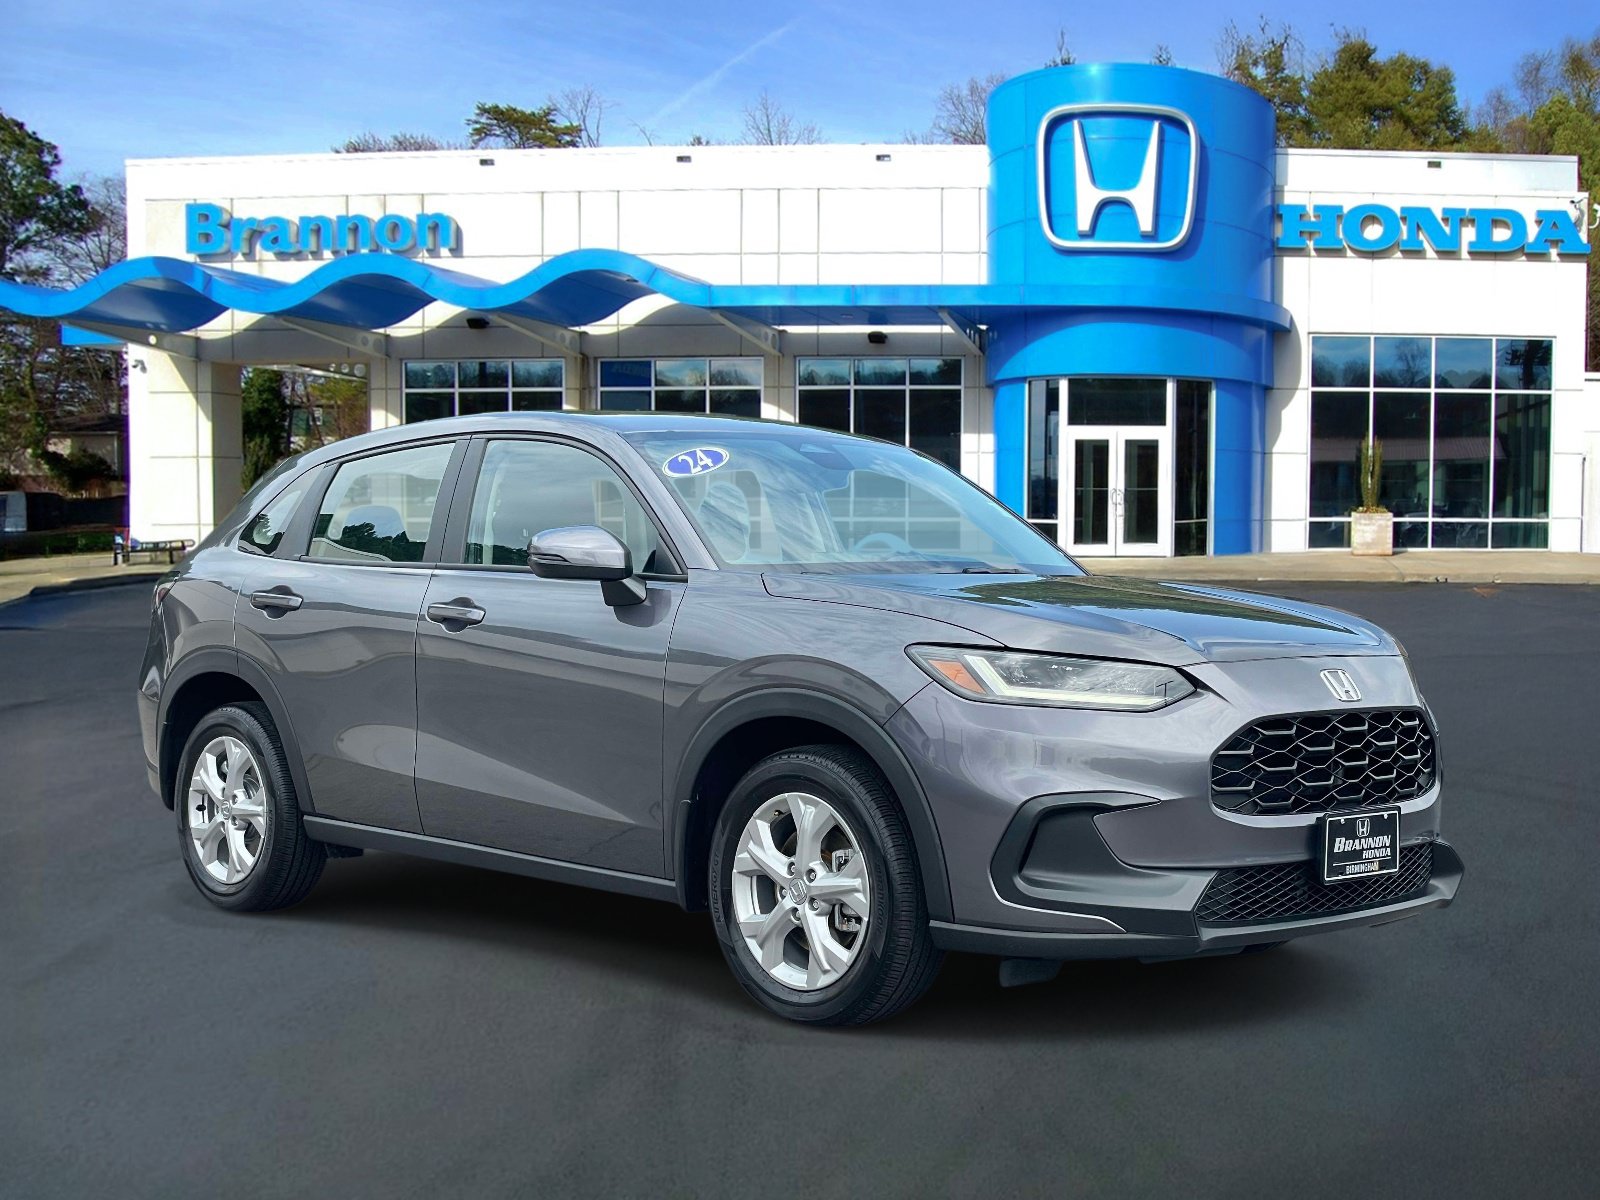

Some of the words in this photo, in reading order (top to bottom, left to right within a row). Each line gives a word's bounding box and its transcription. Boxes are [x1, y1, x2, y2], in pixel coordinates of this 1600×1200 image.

[185, 202, 459, 255] Brannon
[1277, 203, 1592, 255] HONDA
[677, 448, 713, 474] 24
[1334, 835, 1391, 853] BRANNON
[1362, 848, 1391, 859] HONDA
